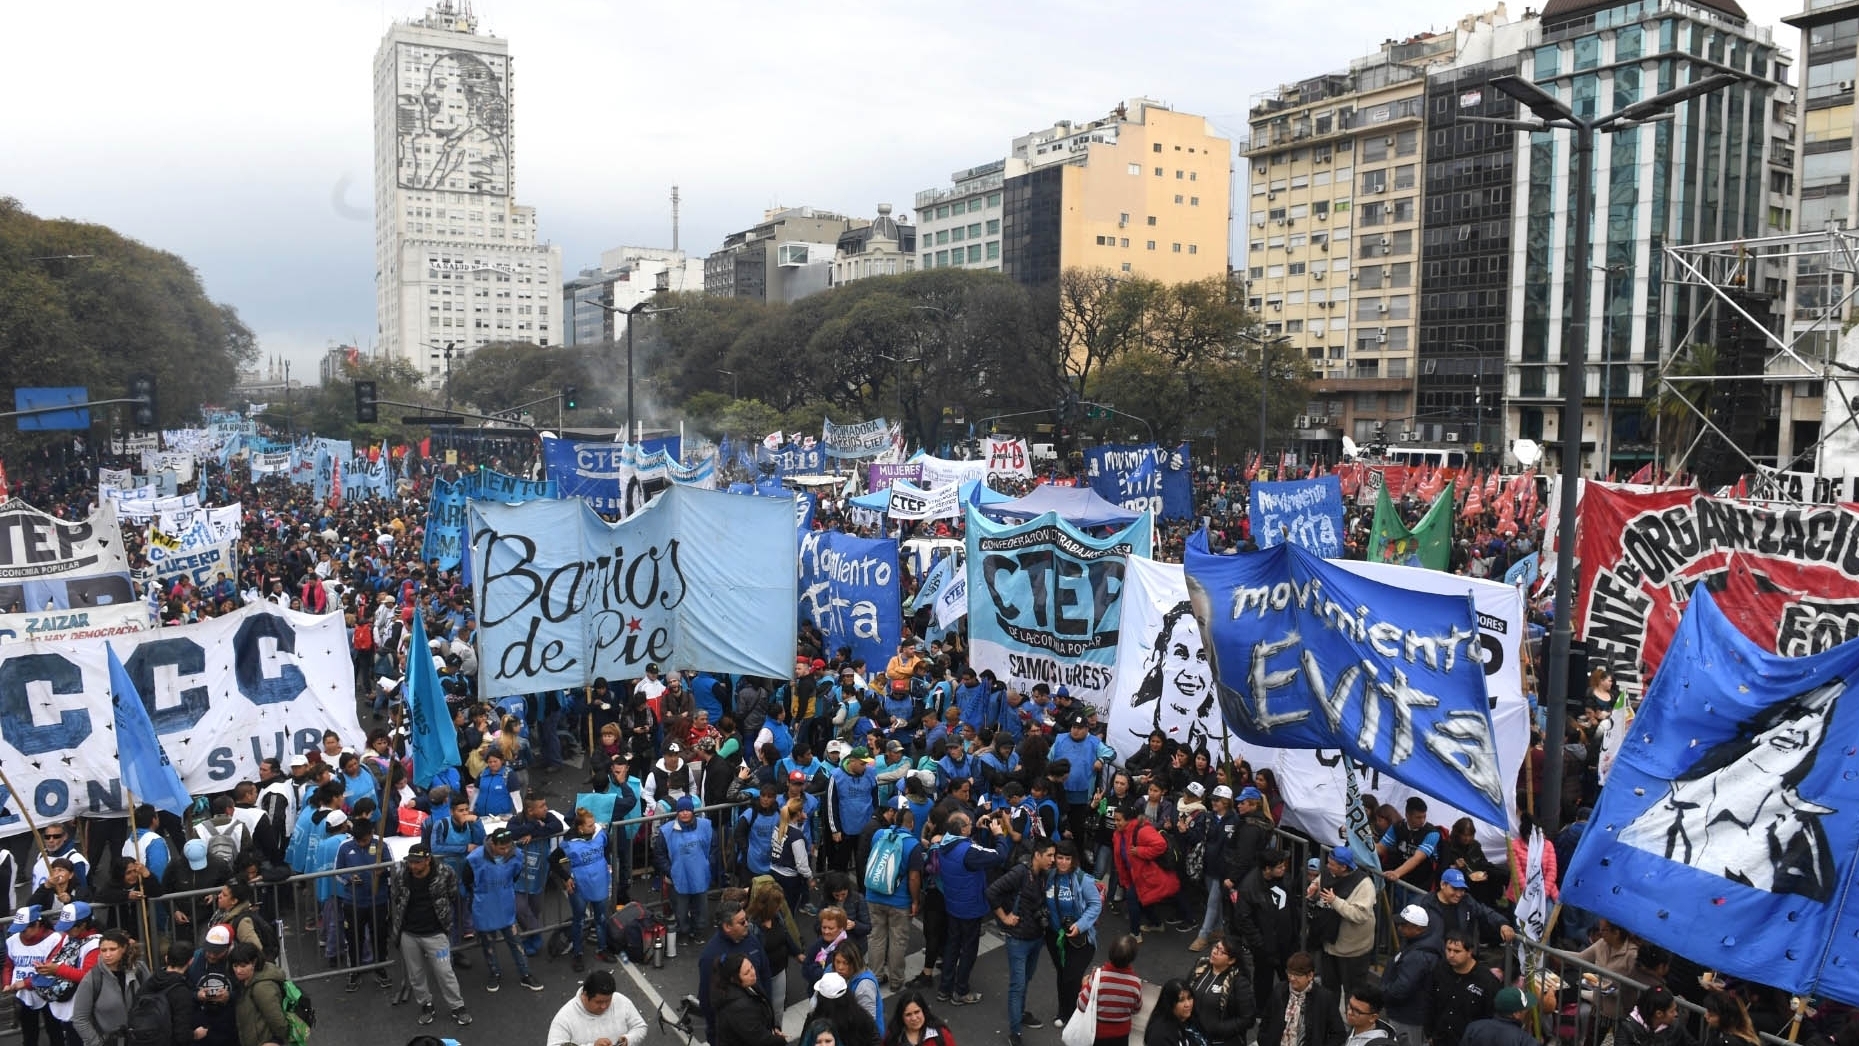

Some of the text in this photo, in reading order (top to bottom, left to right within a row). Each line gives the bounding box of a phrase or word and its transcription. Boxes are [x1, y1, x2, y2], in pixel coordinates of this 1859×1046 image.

[864, 435, 884, 450] CTEP
[577, 449, 621, 470] CTE
[797, 451, 819, 469] 19
[880, 465, 921, 476] MUJERES
[891, 495, 926, 511] CTEP
[41, 561, 80, 574] POPULAR
[157, 549, 220, 575] LUCERO
[472, 528, 687, 628] Barrios
[944, 580, 966, 606] CTEP
[982, 550, 1126, 635] CTEP
[25, 613, 90, 633] ZAIZAR
[70, 624, 140, 640] DEMOCRACIA
[495, 609, 673, 680] de Pie
[1008, 626, 1018, 639] DE
[1020, 630, 1033, 644] LA
[207, 727, 323, 781] SUR
